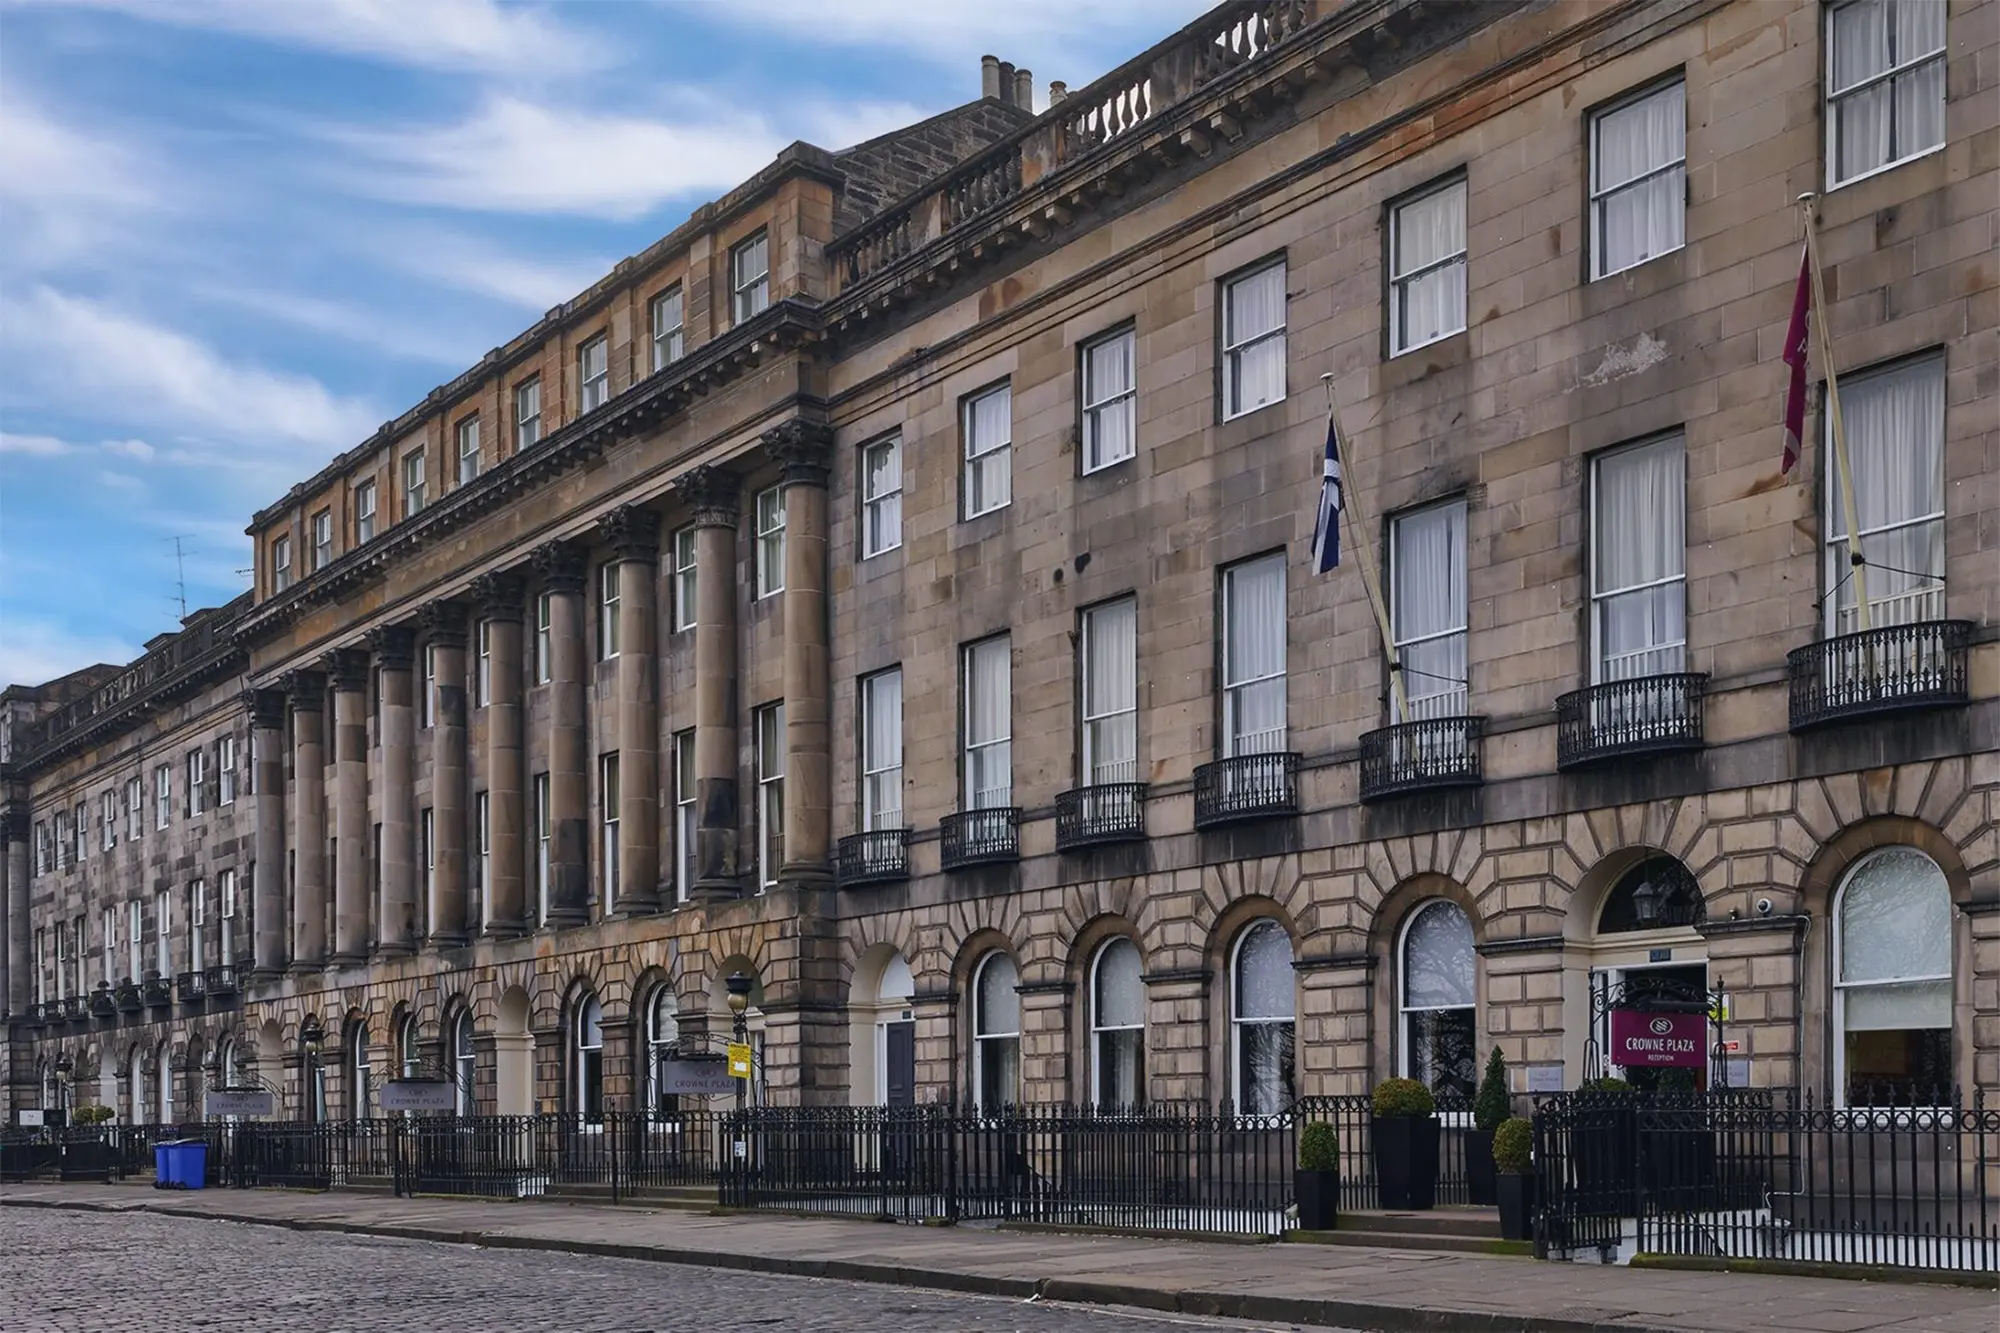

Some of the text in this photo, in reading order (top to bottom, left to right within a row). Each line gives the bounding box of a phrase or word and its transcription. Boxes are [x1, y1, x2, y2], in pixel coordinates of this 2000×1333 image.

[1626, 1037, 1695, 1052] CROWNE PLAZA
[674, 1080, 735, 1088] CROWNE PLAZA
